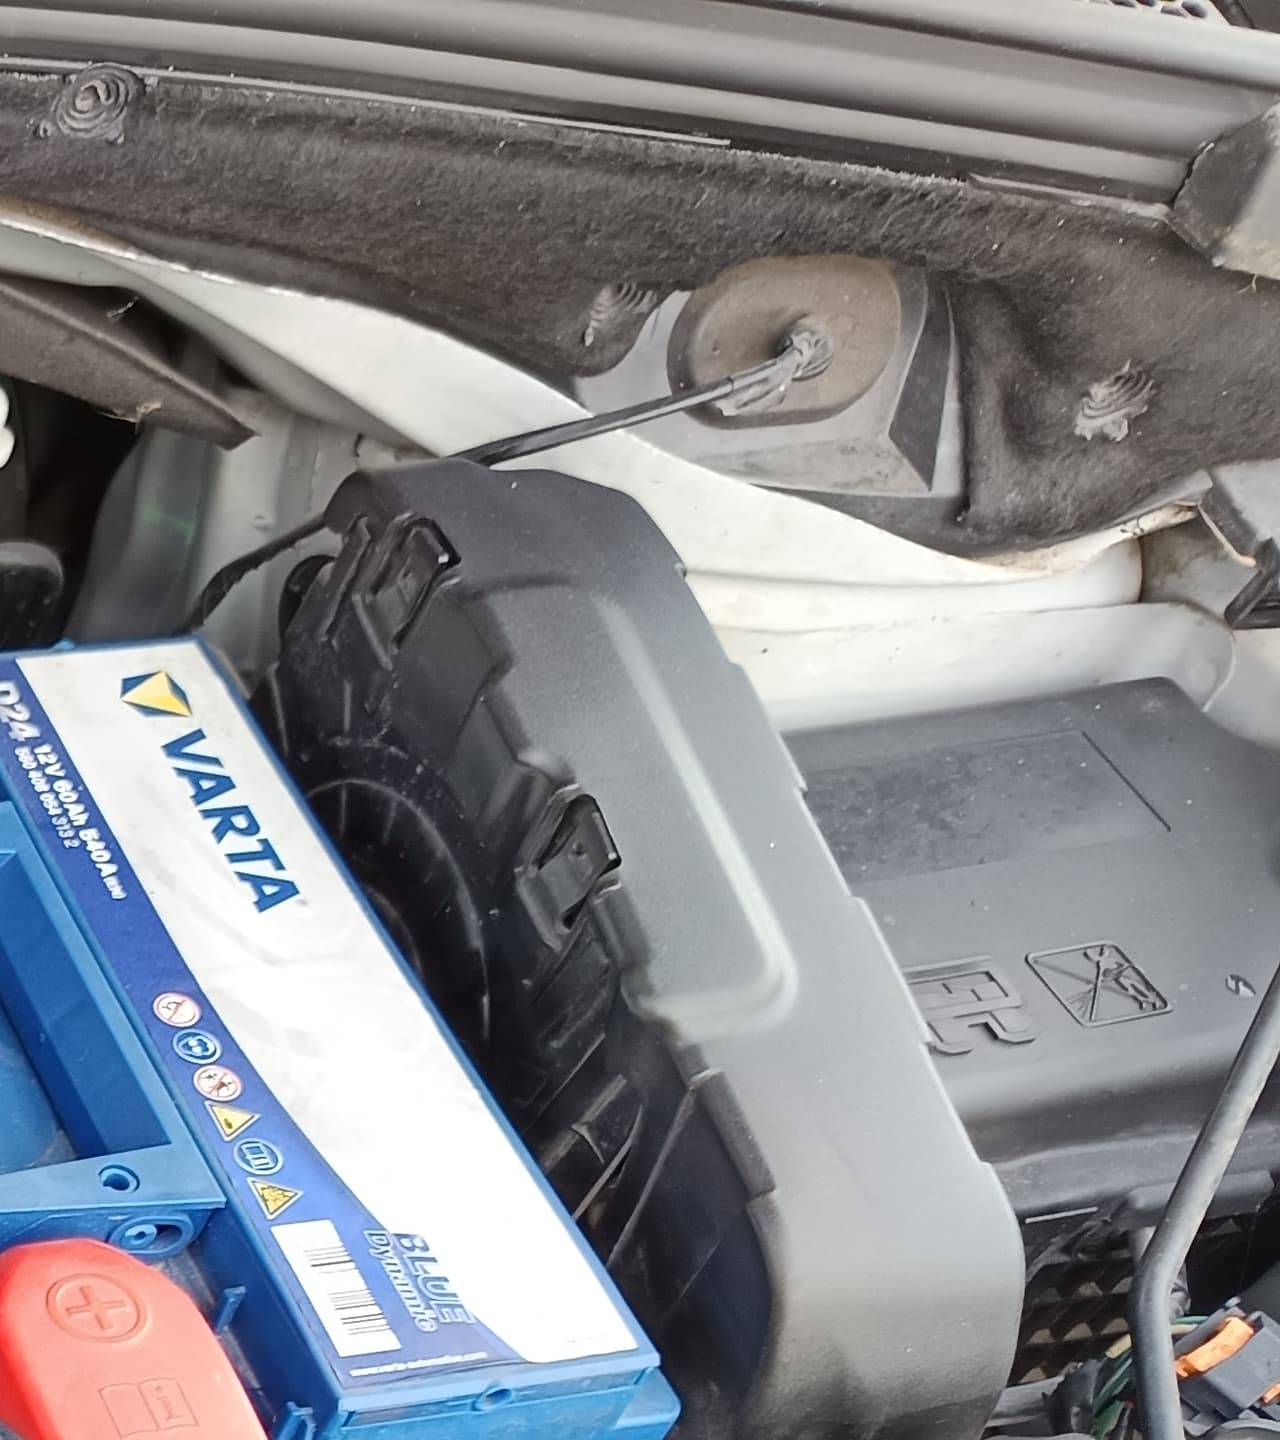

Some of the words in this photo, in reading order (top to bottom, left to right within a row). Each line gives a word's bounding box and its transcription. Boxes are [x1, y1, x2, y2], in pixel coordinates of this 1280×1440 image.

[33, 742, 66, 778] 12V
[53, 778, 90, 827] 60Ah
[160, 728, 300, 914] VARTA
[362, 1229, 439, 1333] Dynamic
[391, 1232, 477, 1324] BLUE
